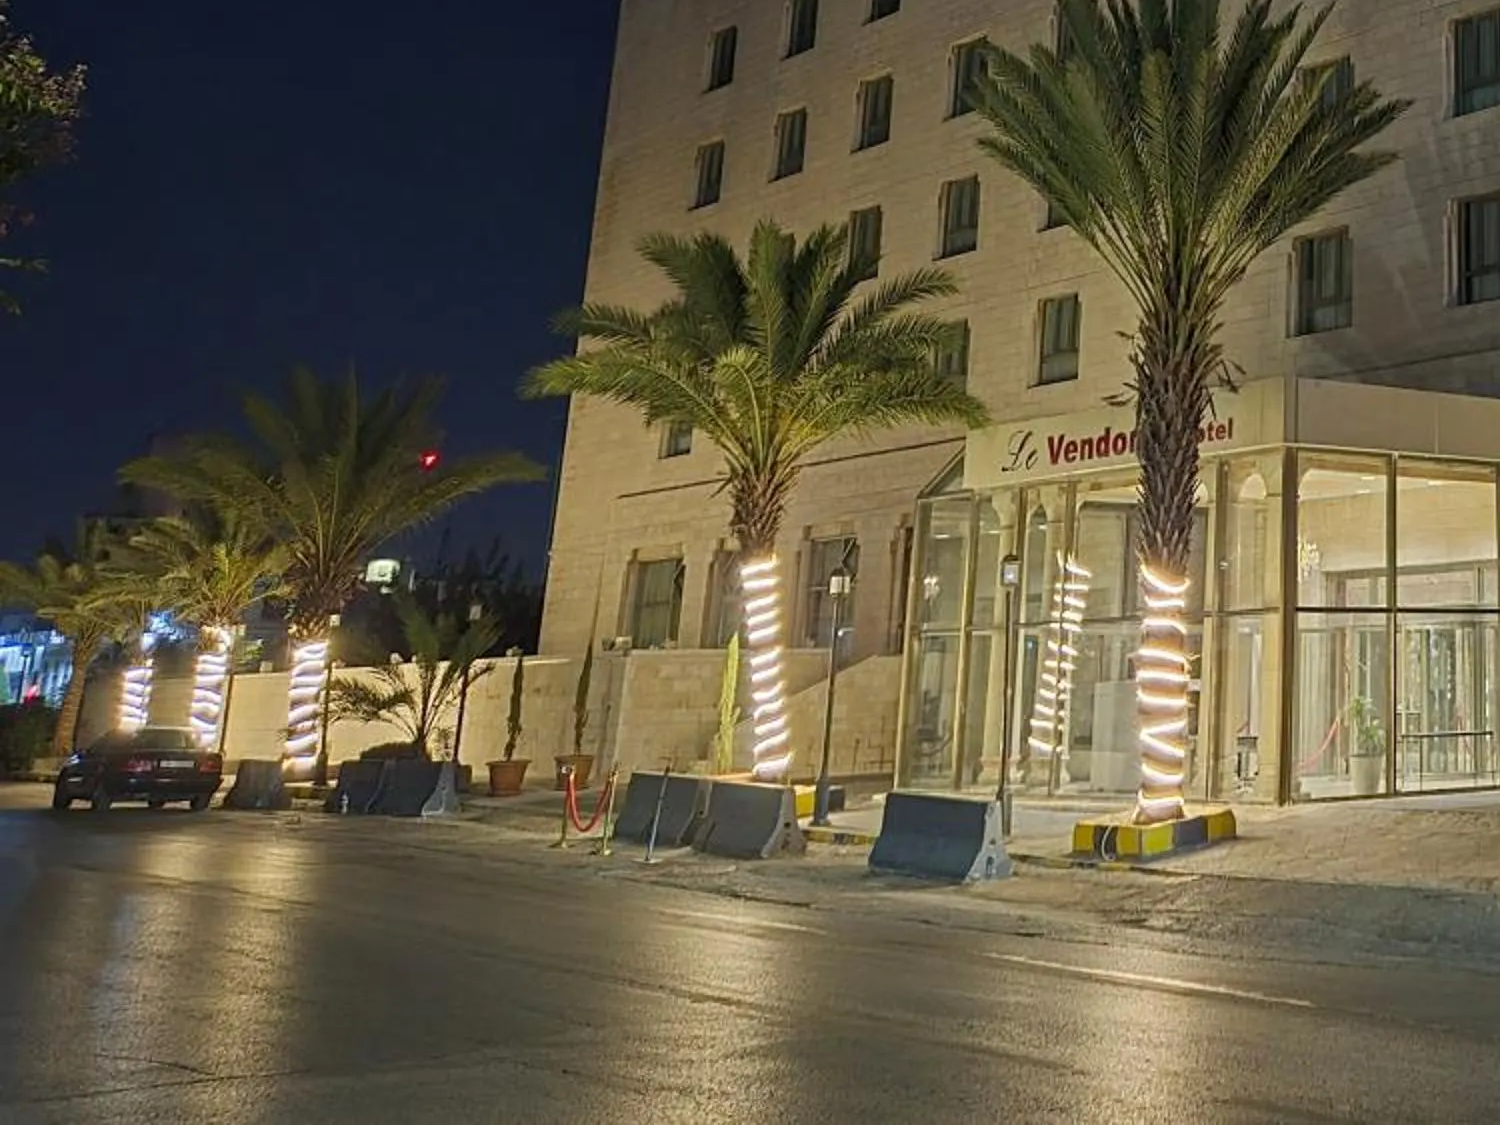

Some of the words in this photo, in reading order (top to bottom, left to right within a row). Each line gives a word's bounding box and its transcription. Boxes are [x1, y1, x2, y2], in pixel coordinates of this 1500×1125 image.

[1001, 429, 1039, 473] Le
[1047, 426, 1138, 465] Vendo
[1197, 417, 1234, 443] otel
